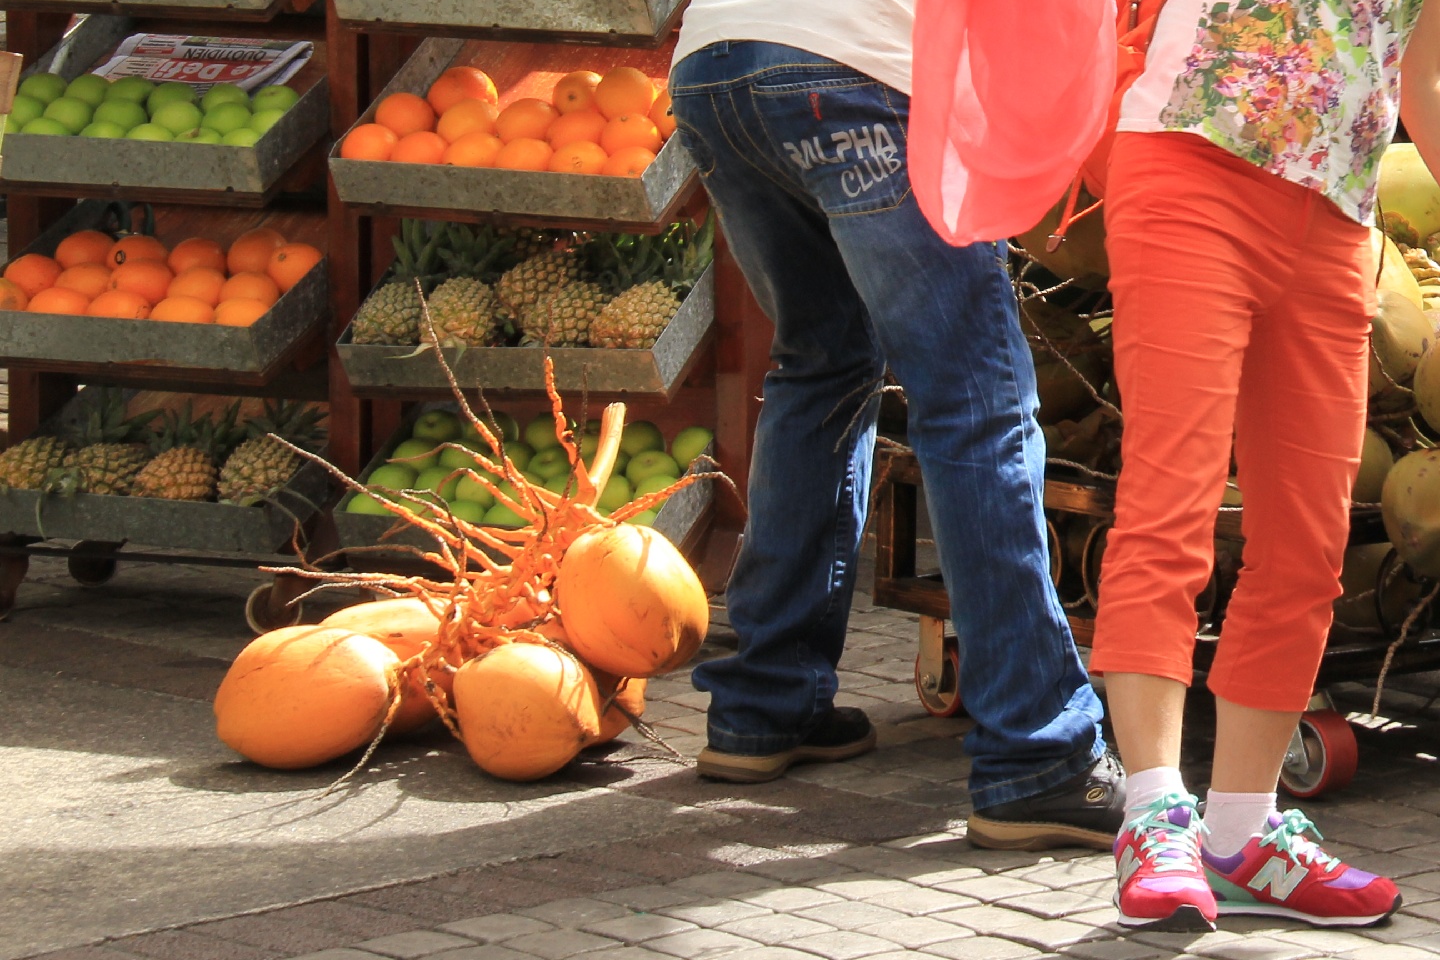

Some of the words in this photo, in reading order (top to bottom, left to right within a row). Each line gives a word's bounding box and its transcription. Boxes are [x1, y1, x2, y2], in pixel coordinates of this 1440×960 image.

[183, 48, 267, 61] QUOTIDIEN
[155, 61, 228, 81] Défi
[841, 150, 901, 198] CLUB
[1247, 856, 1309, 901] N
